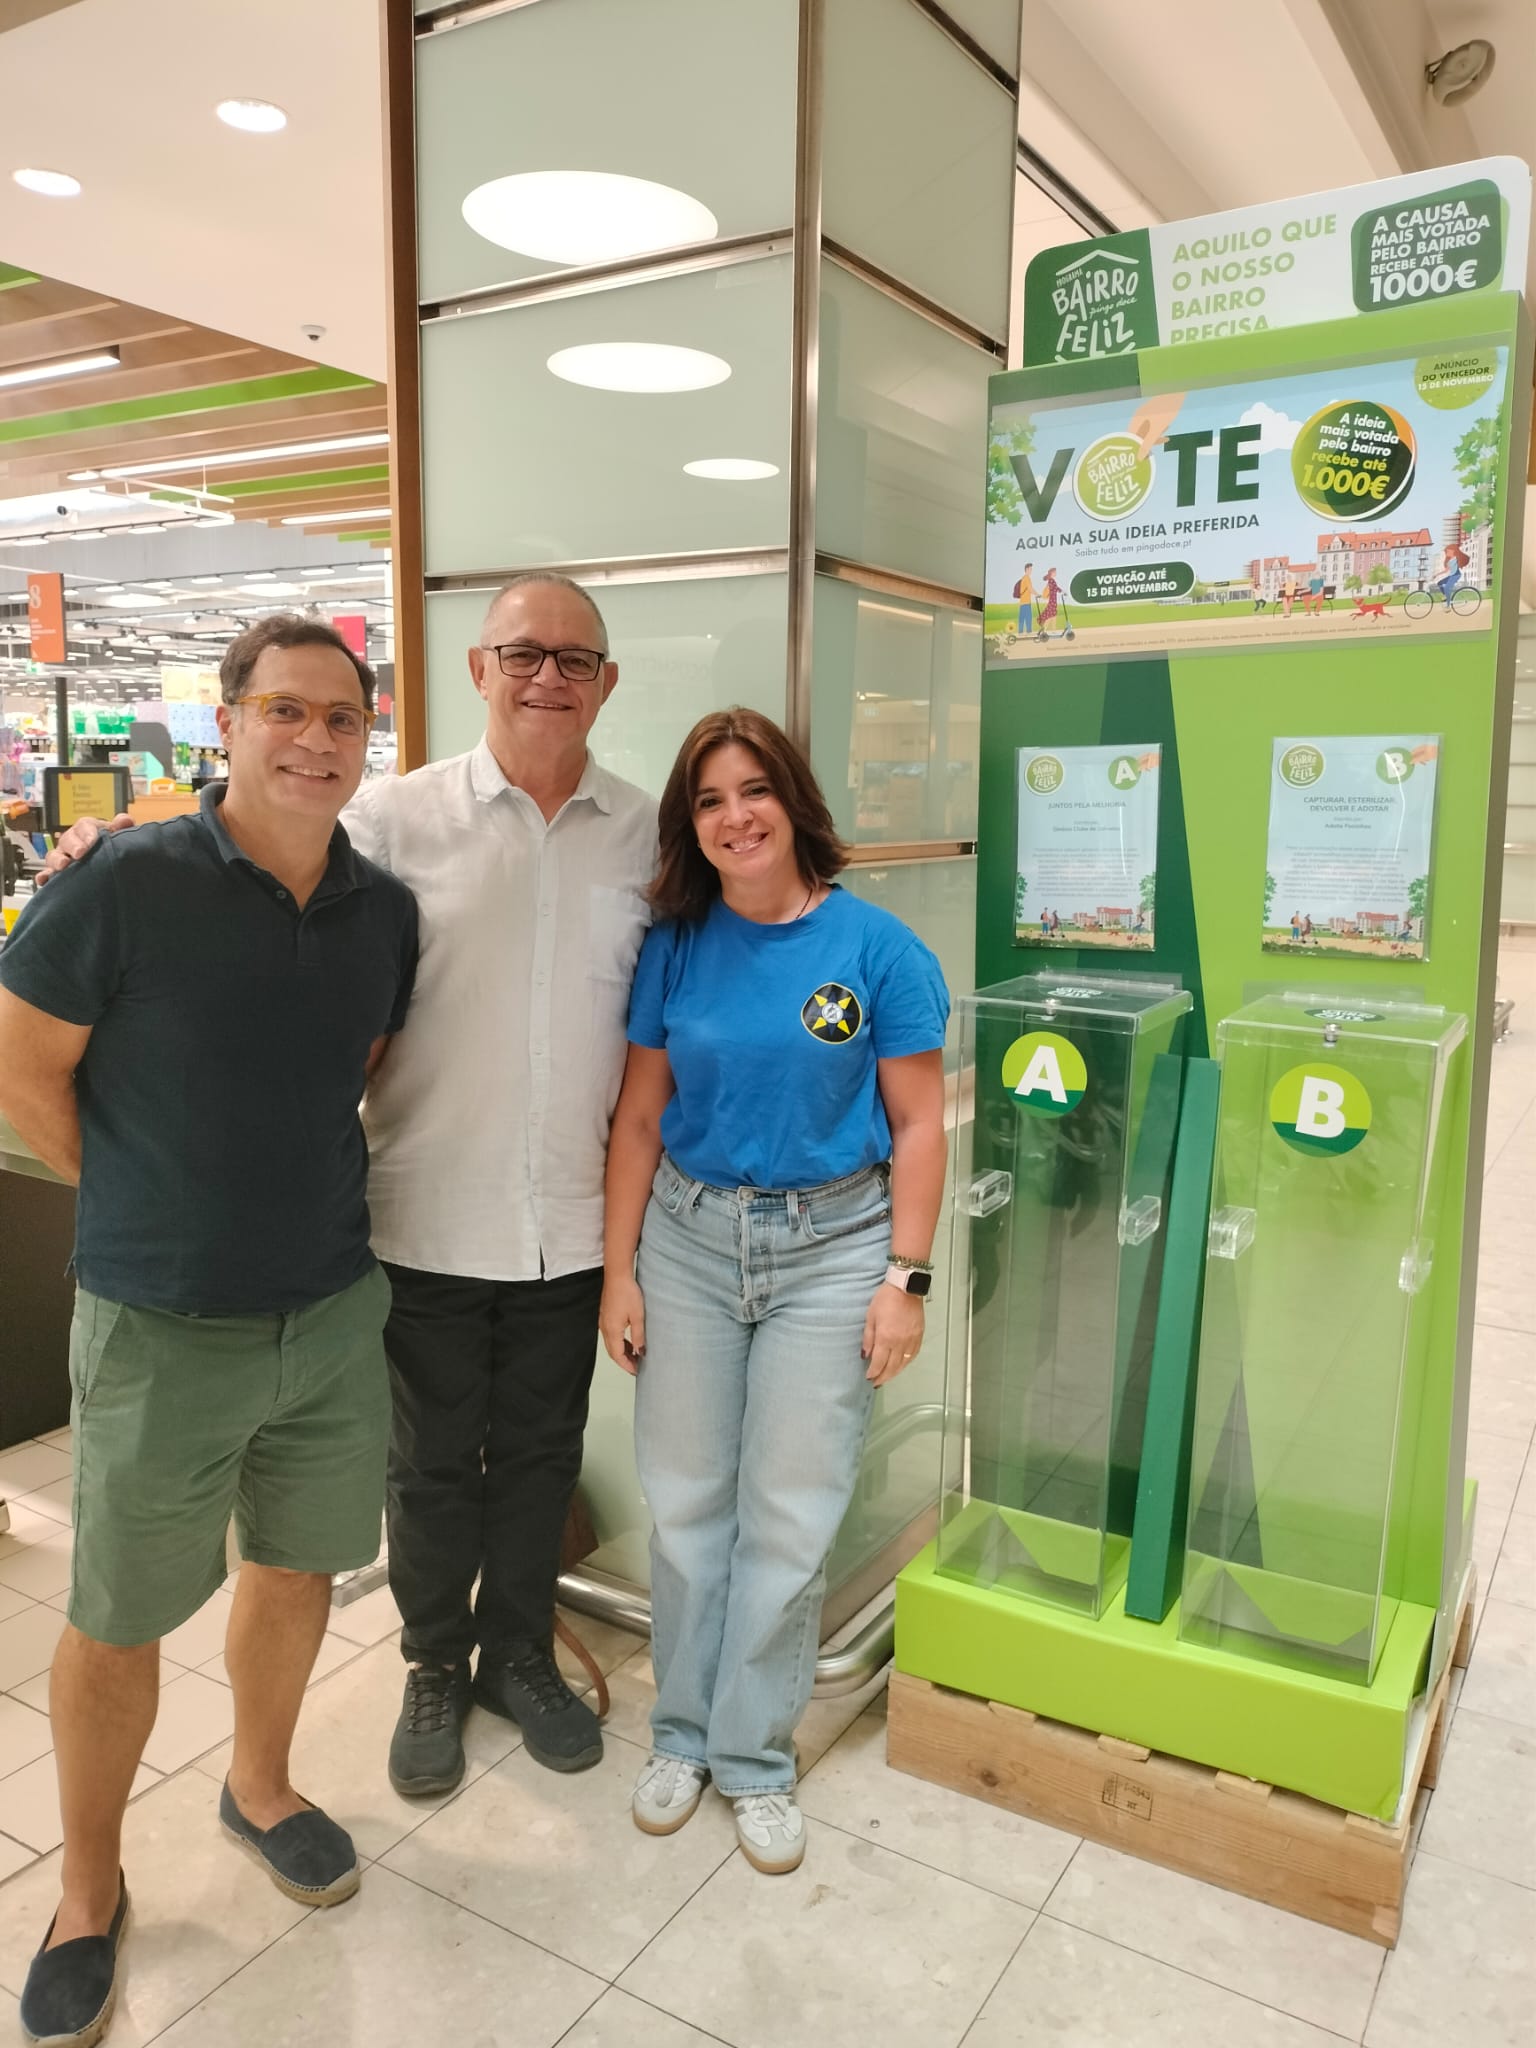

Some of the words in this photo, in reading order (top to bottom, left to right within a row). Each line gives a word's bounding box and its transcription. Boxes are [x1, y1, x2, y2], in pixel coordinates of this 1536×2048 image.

[1372, 215, 1389, 234] A
[1395, 200, 1470, 229] CAUSA
[1172, 226, 1272, 264] AQUILO
[1281, 213, 1337, 243] QUE
[1371, 228, 1414, 248] MAIS
[1419, 215, 1491, 240] VOTADA
[1371, 243, 1412, 263] PELO
[1416, 231, 1481, 255] BAIRRO
[1172, 271, 1192, 292] O
[1201, 251, 1296, 287] NOSSO
[1370, 257, 1417, 276] RECEBE
[1420, 250, 1444, 267] ATÉ
[1369, 259, 1478, 304] 1000€
[1171, 285, 1267, 321] BAIRRO
[1170, 315, 1269, 345] PRECISA
[1422, 373, 1437, 382] DO
[1439, 366, 1490, 380] VENCEDOR
[1433, 357, 1479, 371] ANÚNCIO
[1418, 382, 1428, 391] 15
[1429, 380, 1441, 389] DE
[1442, 374, 1495, 388] NOVEMBRO
[1339, 412, 1350, 425] A
[1354, 413, 1387, 430] ideia
[1318, 437, 1349, 450] pelo
[1350, 439, 1392, 457] bairro
[1320, 424, 1351, 437] mais
[1354, 430, 1400, 445] votada
[1311, 451, 1360, 468] recebe
[1362, 458, 1388, 472] até
[1302, 463, 1391, 501] 1.000€
[1015, 534, 1054, 551] AQUI
[1059, 531, 1083, 546] NA
[1089, 528, 1120, 544] SUA
[1125, 523, 1167, 540] IDEIA
[1173, 513, 1260, 535] PREFERIDA
[1074, 546, 1099, 558] Saiba
[1100, 545, 1119, 556] tudo
[1121, 545, 1134, 553] em
[1136, 538, 1192, 555] pingodoce.pt
[1086, 587, 1098, 598] 15
[1100, 585, 1114, 597] DE
[1116, 580, 1177, 595] NOVEMBRO
[1096, 570, 1146, 586] VOTAÇÃO
[1148, 567, 1167, 581] ATÉ
[30, 584, 41, 609] 8
[1114, 759, 1137, 785] A
[1385, 752, 1407, 778] B
[1015, 1045, 1068, 1104] A
[1295, 1075, 1347, 1139] B
